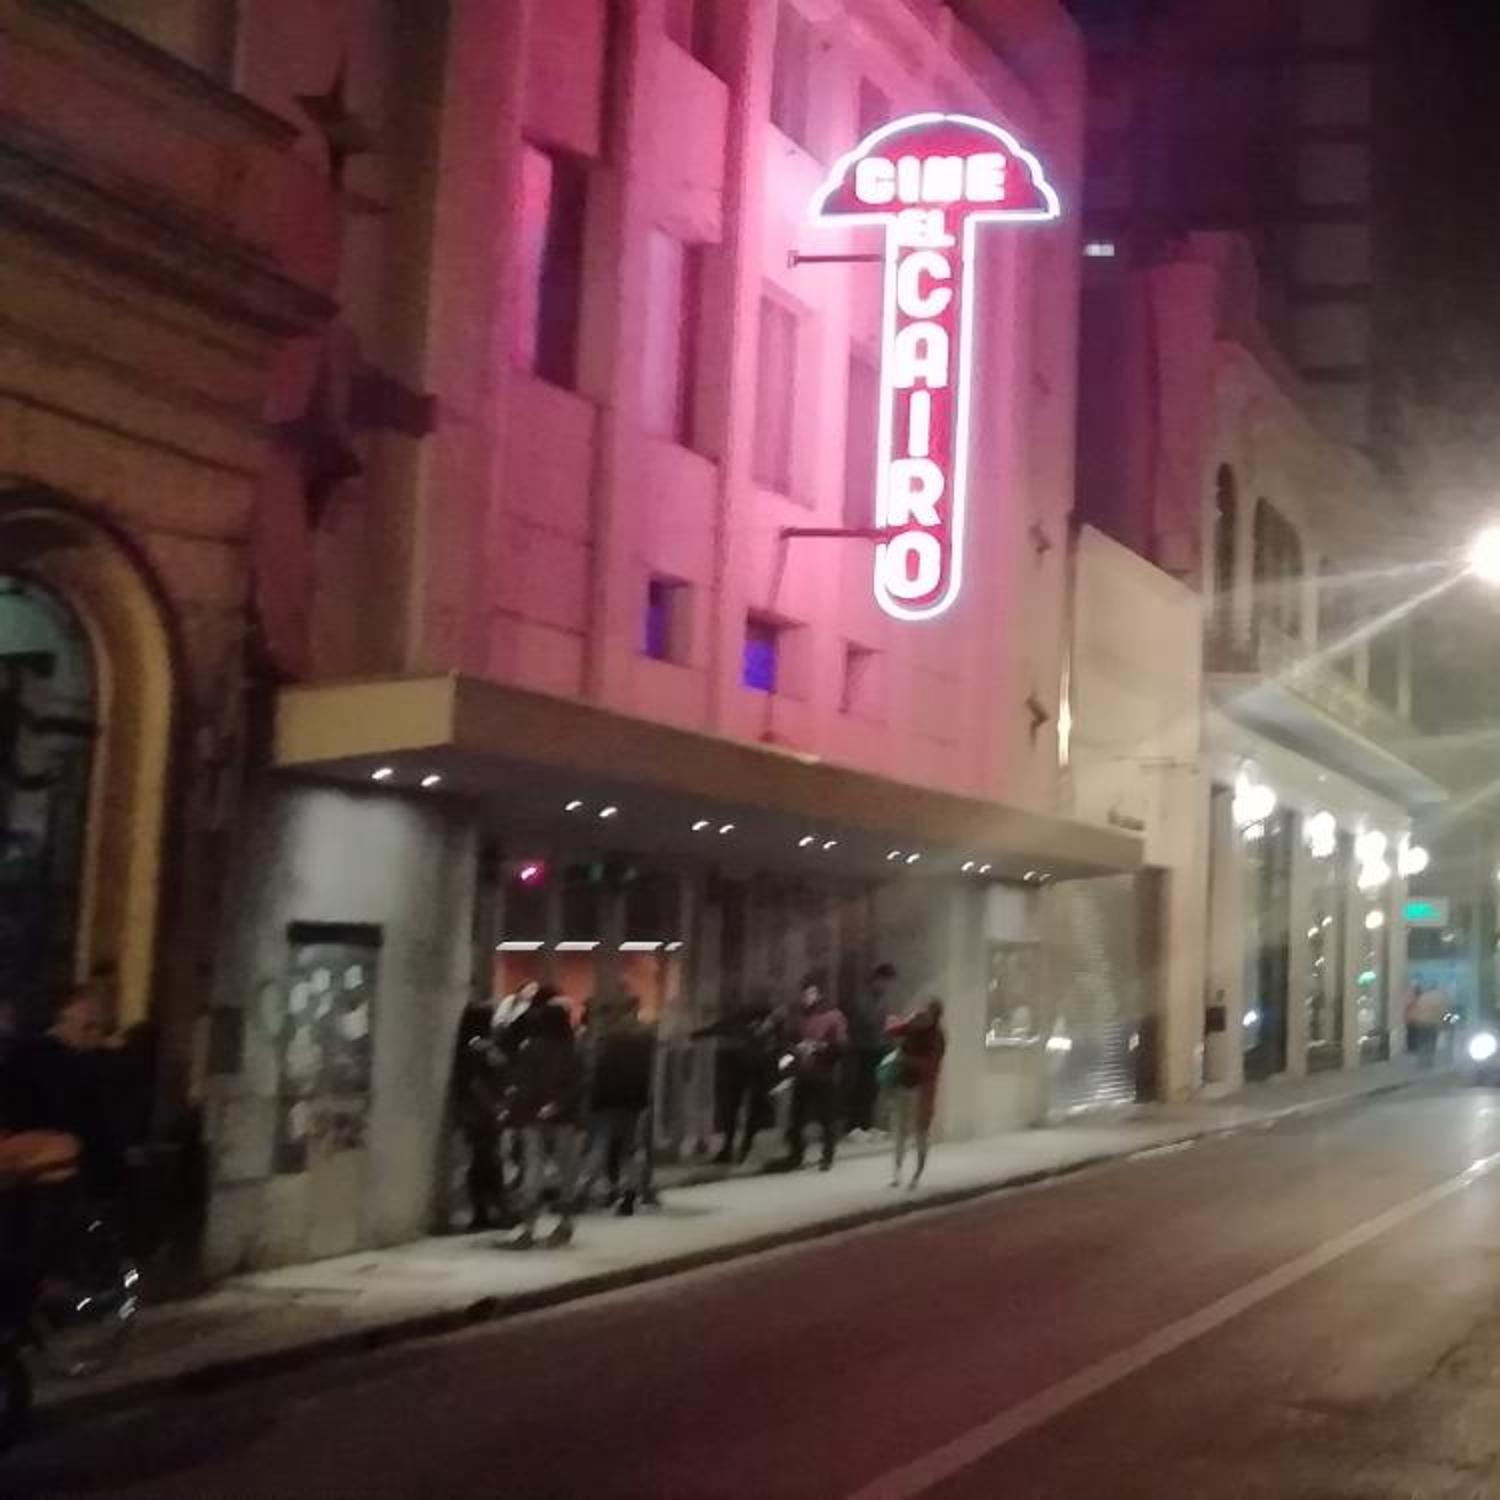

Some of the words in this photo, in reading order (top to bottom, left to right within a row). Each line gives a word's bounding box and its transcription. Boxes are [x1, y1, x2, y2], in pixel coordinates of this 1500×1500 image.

[855, 153, 1007, 204] CINE
[897, 208, 955, 248] EL
[886, 251, 952, 599] CAIRO
